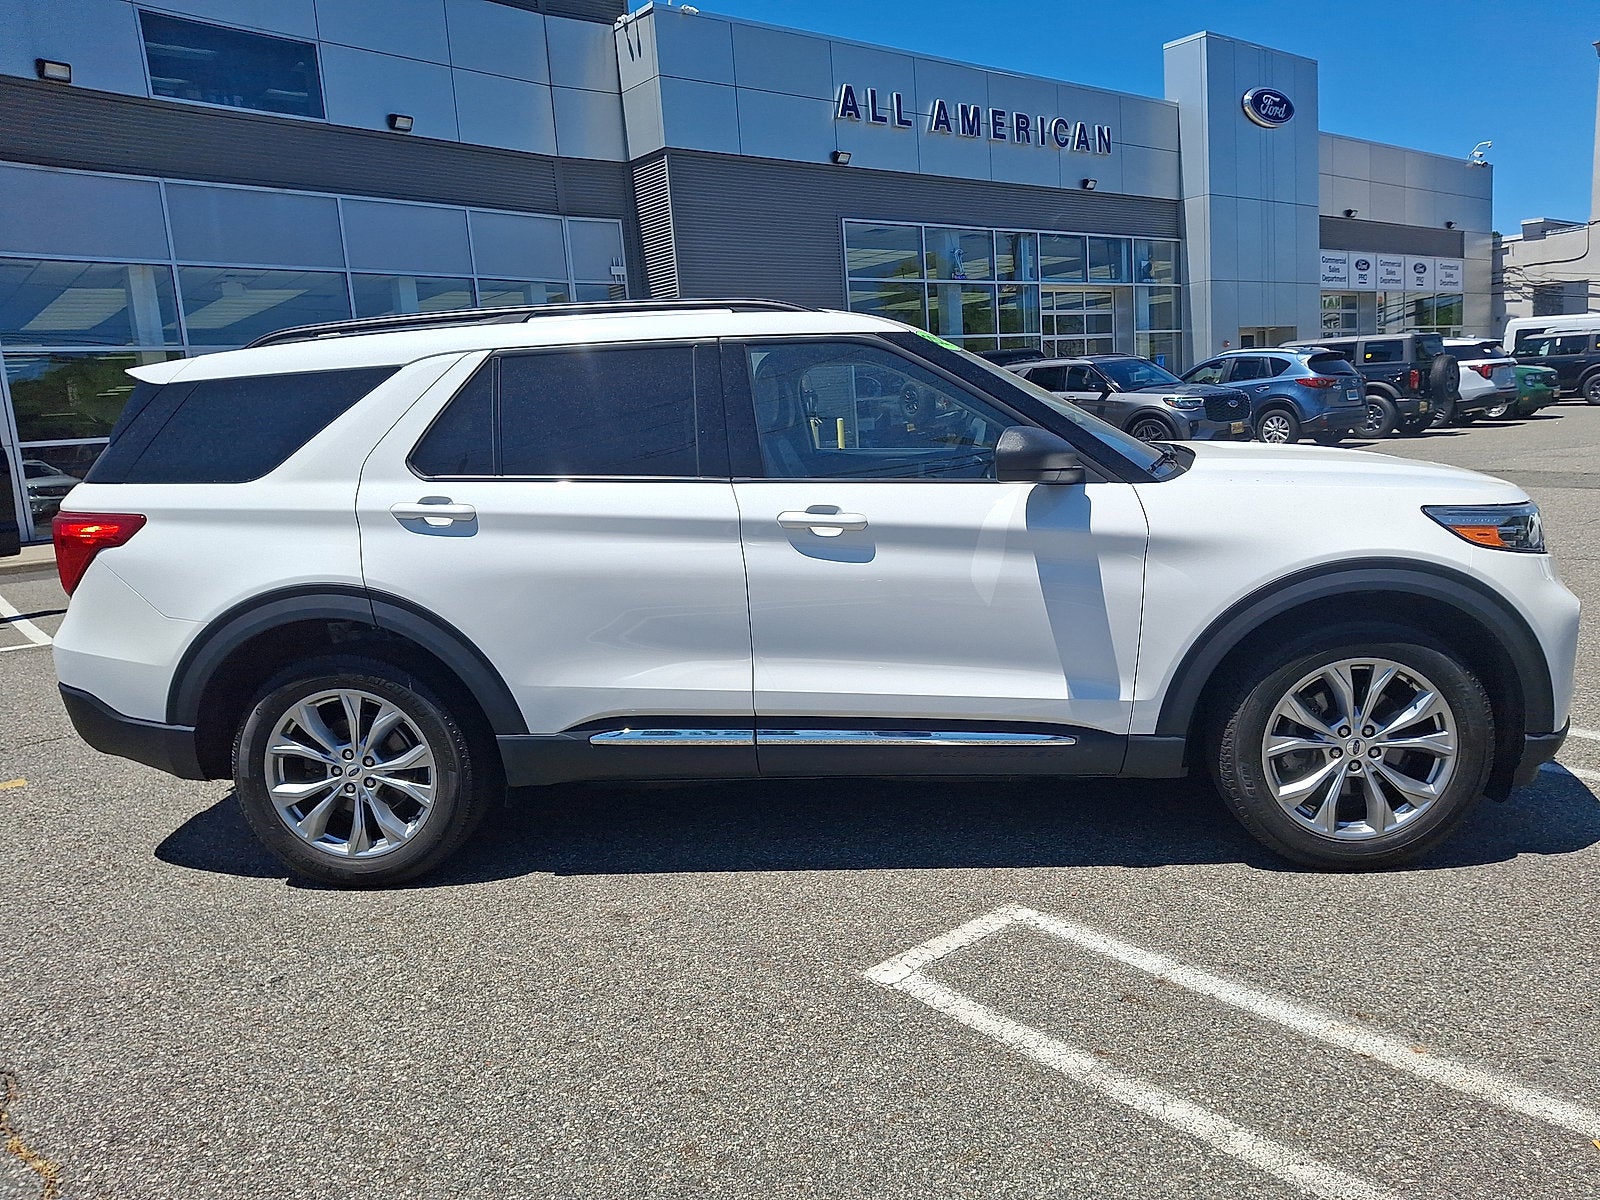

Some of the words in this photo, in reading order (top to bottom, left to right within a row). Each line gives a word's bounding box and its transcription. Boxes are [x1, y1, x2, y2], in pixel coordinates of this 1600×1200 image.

[1259, 93, 1288, 119] Ford
[839, 83, 913, 128] ALL
[931, 98, 1112, 155] AMERICAN
[1321, 256, 1347, 265] Commercial
[1379, 259, 1402, 268] Commercial
[1328, 265, 1341, 274] Sales
[1385, 268, 1396, 276] Sales
[1321, 274, 1347, 283] Department
[1358, 273, 1368, 281] PRO
[1379, 276, 1402, 285] Department
